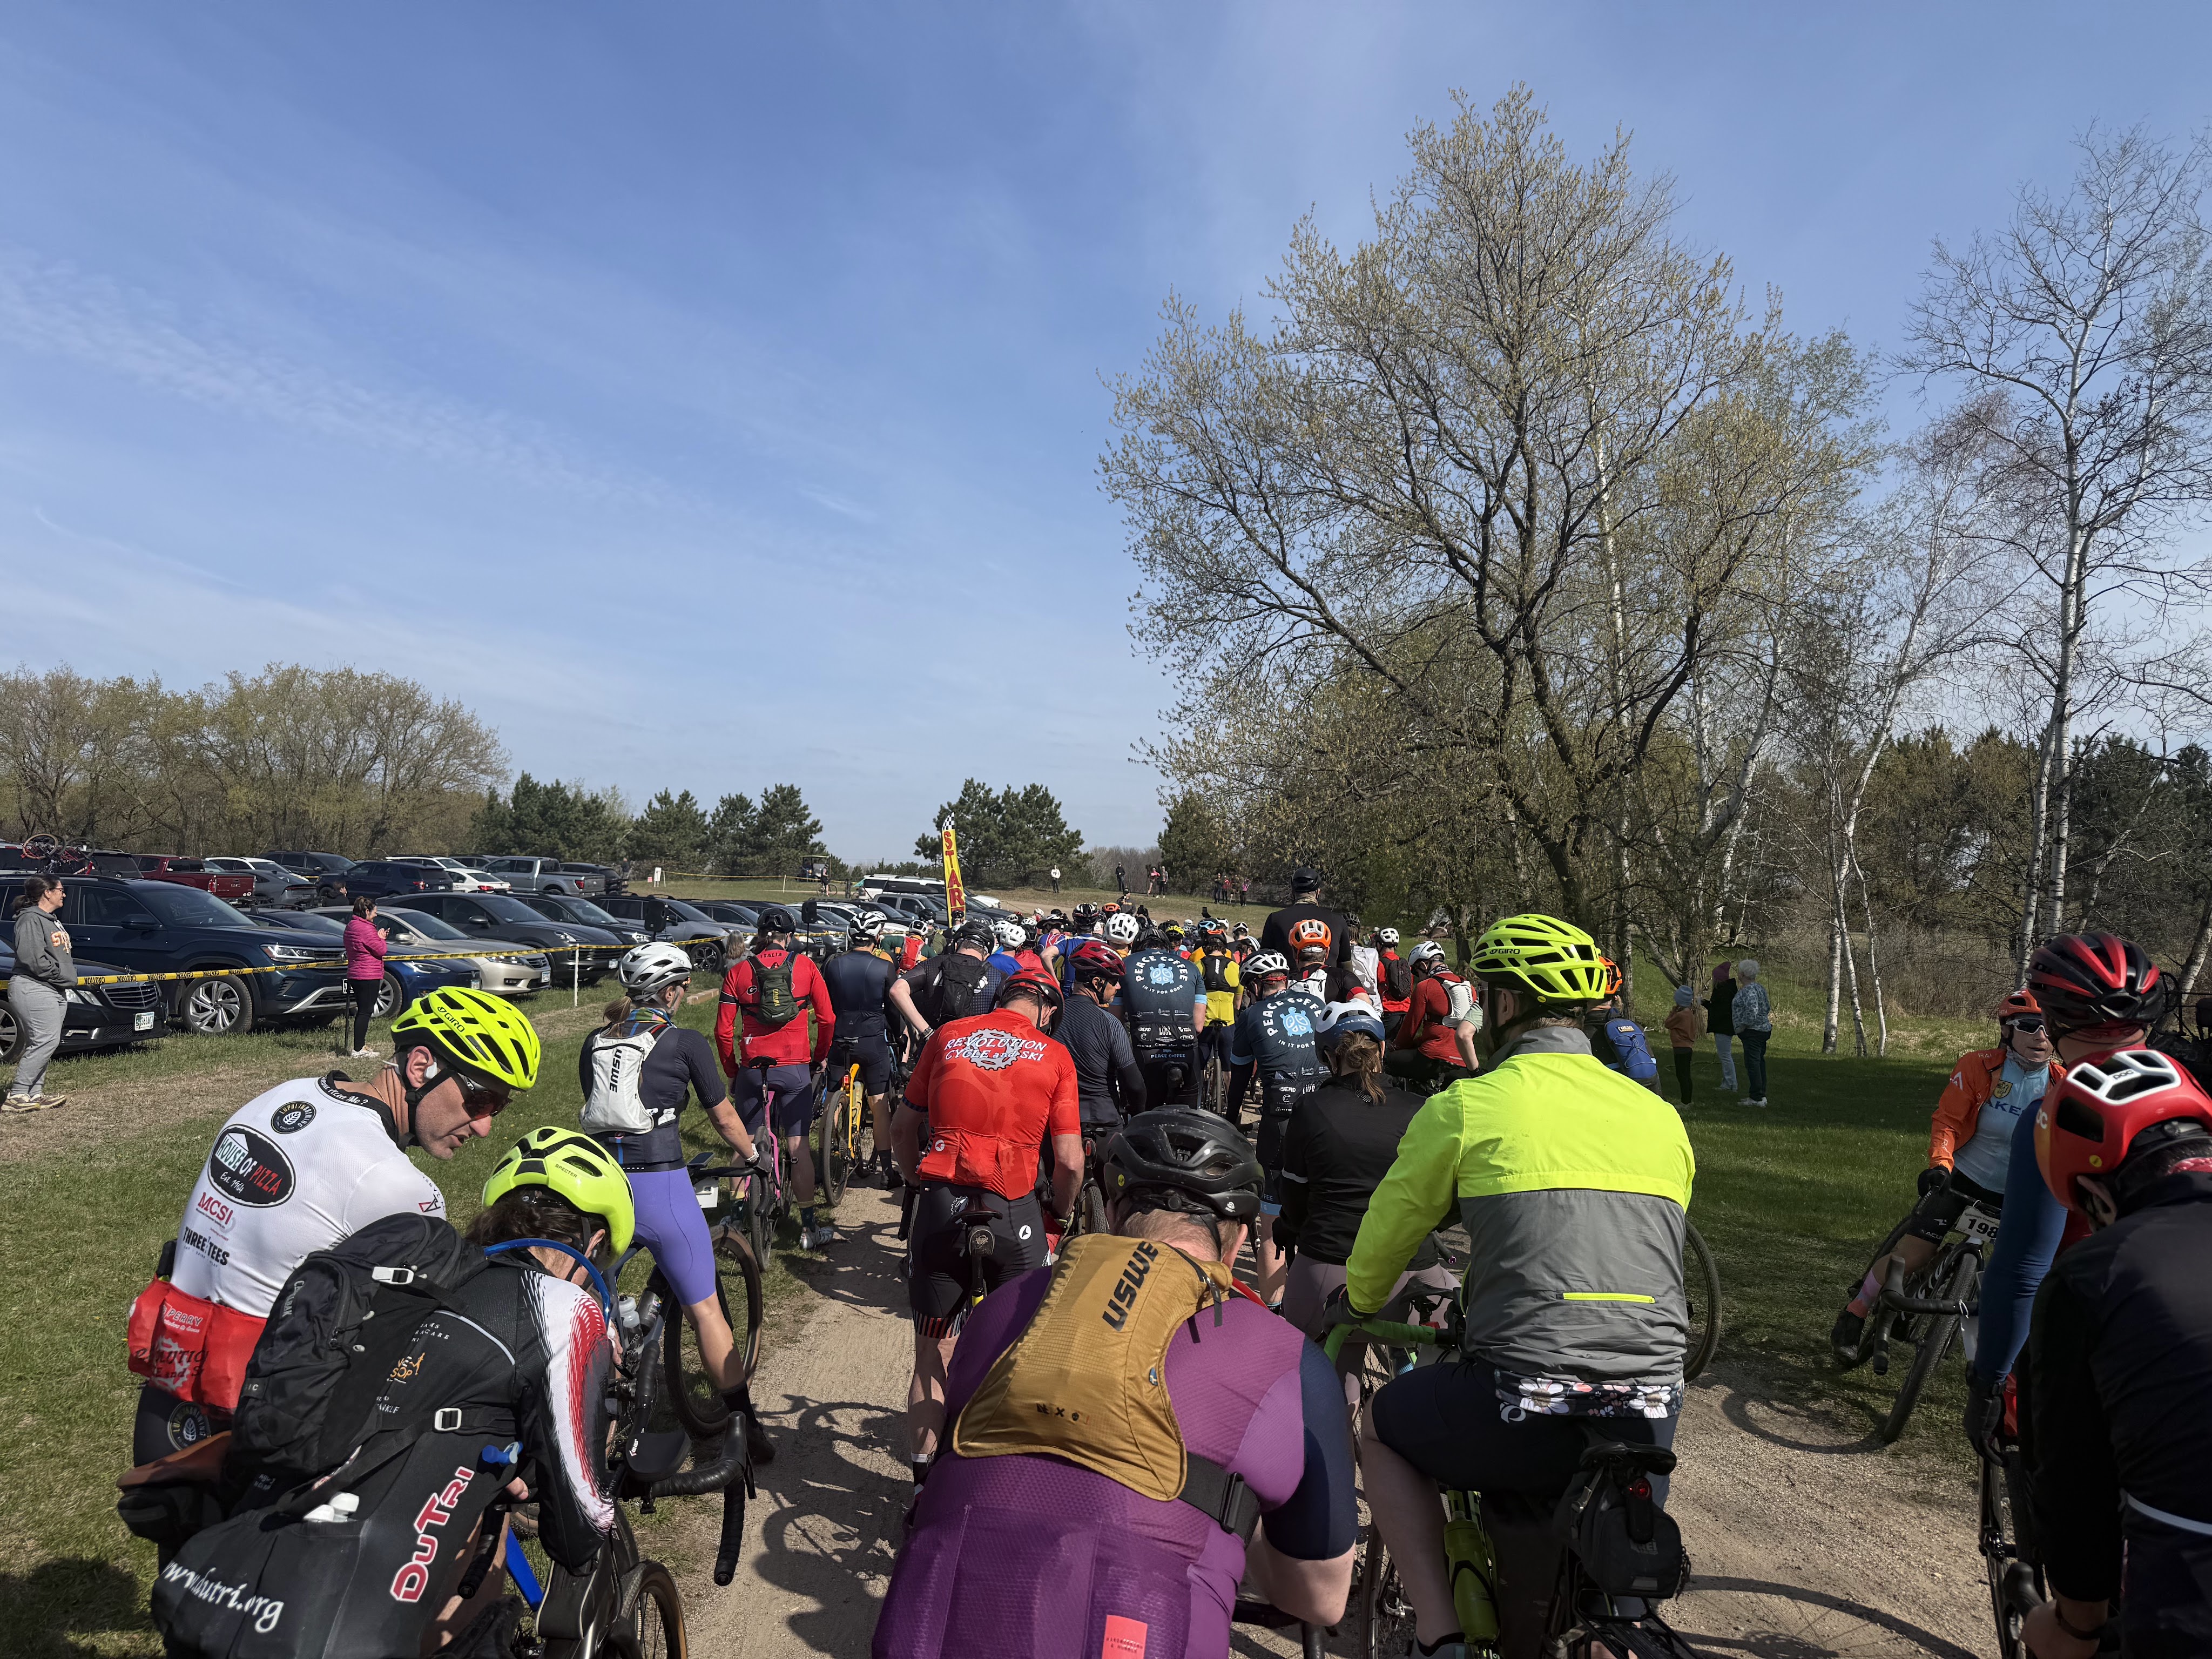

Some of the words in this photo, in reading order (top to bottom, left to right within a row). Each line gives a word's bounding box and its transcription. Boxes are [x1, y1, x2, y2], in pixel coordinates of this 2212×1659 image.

[1134, 955, 1157, 982] PEACE
[1160, 956, 1188, 981] COFFEE
[84, 976, 105, 986] CAUTION
[1170, 984, 1183, 993] GOOD
[444, 1013, 465, 1032] GIRO
[1263, 1001, 1284, 1036] PEACE
[1287, 997, 1321, 1017] COFFE
[944, 1036, 1048, 1051] REVOLUTION
[945, 1049, 991, 1060] CYCLE
[993, 1049, 1019, 1058] and
[1020, 1051, 1044, 1061] SKI
[610, 1049, 622, 1092] USWE
[279, 1103, 306, 1114] LUPULIN
[2036, 1109, 2048, 1129] OC
[217, 1136, 246, 1169] HOUSE
[239, 1157, 258, 1177] OF
[555, 1164, 577, 1178] SPECTER
[220, 1171, 230, 1184] Est.
[231, 1178, 245, 1193] 1964
[248, 1164, 283, 1195] PIZZA
[198, 1192, 233, 1225] MCSI
[183, 1226, 208, 1253] THREE
[207, 1242, 230, 1265] TEES
[1102, 1241, 1159, 1332] USWE
[168, 1308, 203, 1326] PERRY
